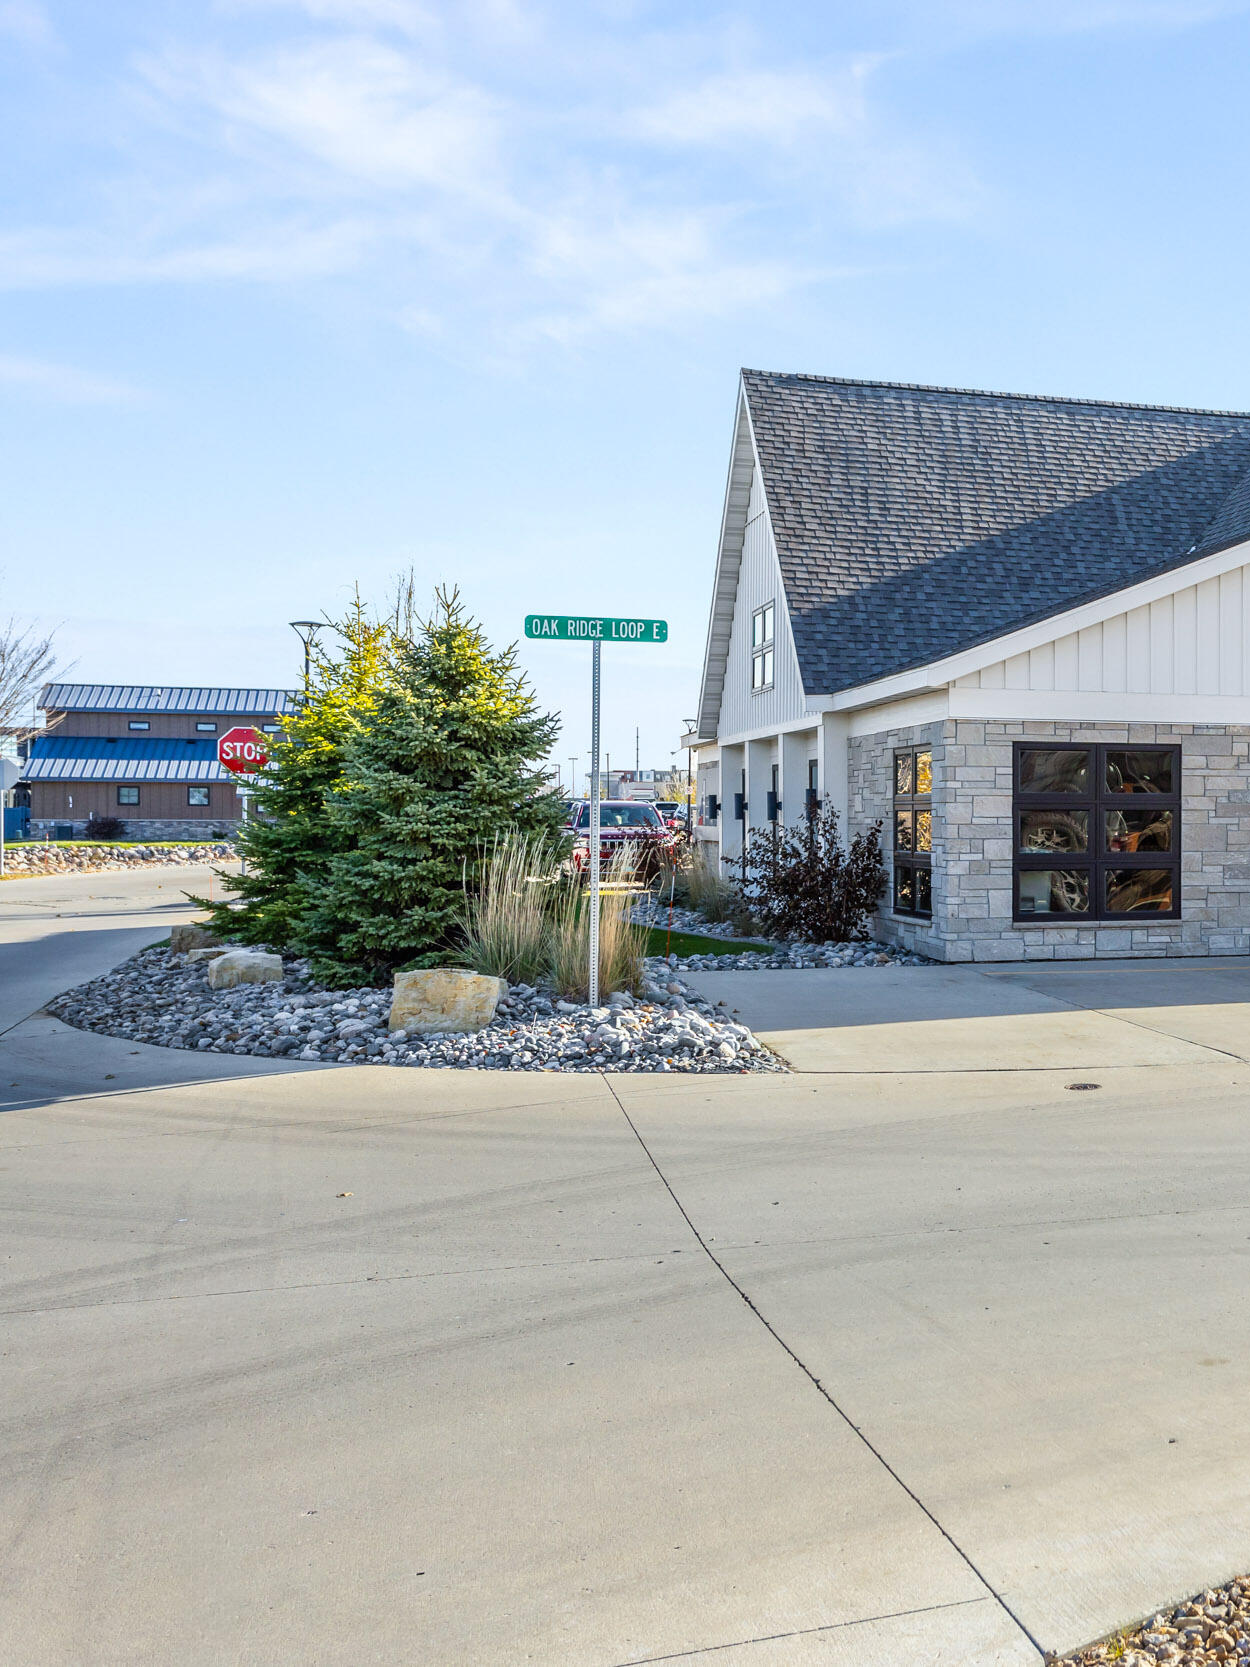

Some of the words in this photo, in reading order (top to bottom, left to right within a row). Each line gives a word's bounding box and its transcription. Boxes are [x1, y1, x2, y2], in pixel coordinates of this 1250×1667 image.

[532, 619, 559, 636] OAK
[567, 620, 604, 637] RIDGE
[612, 621, 645, 638] LOOP
[653, 623, 660, 639] E
[222, 742, 267, 760] STOP
